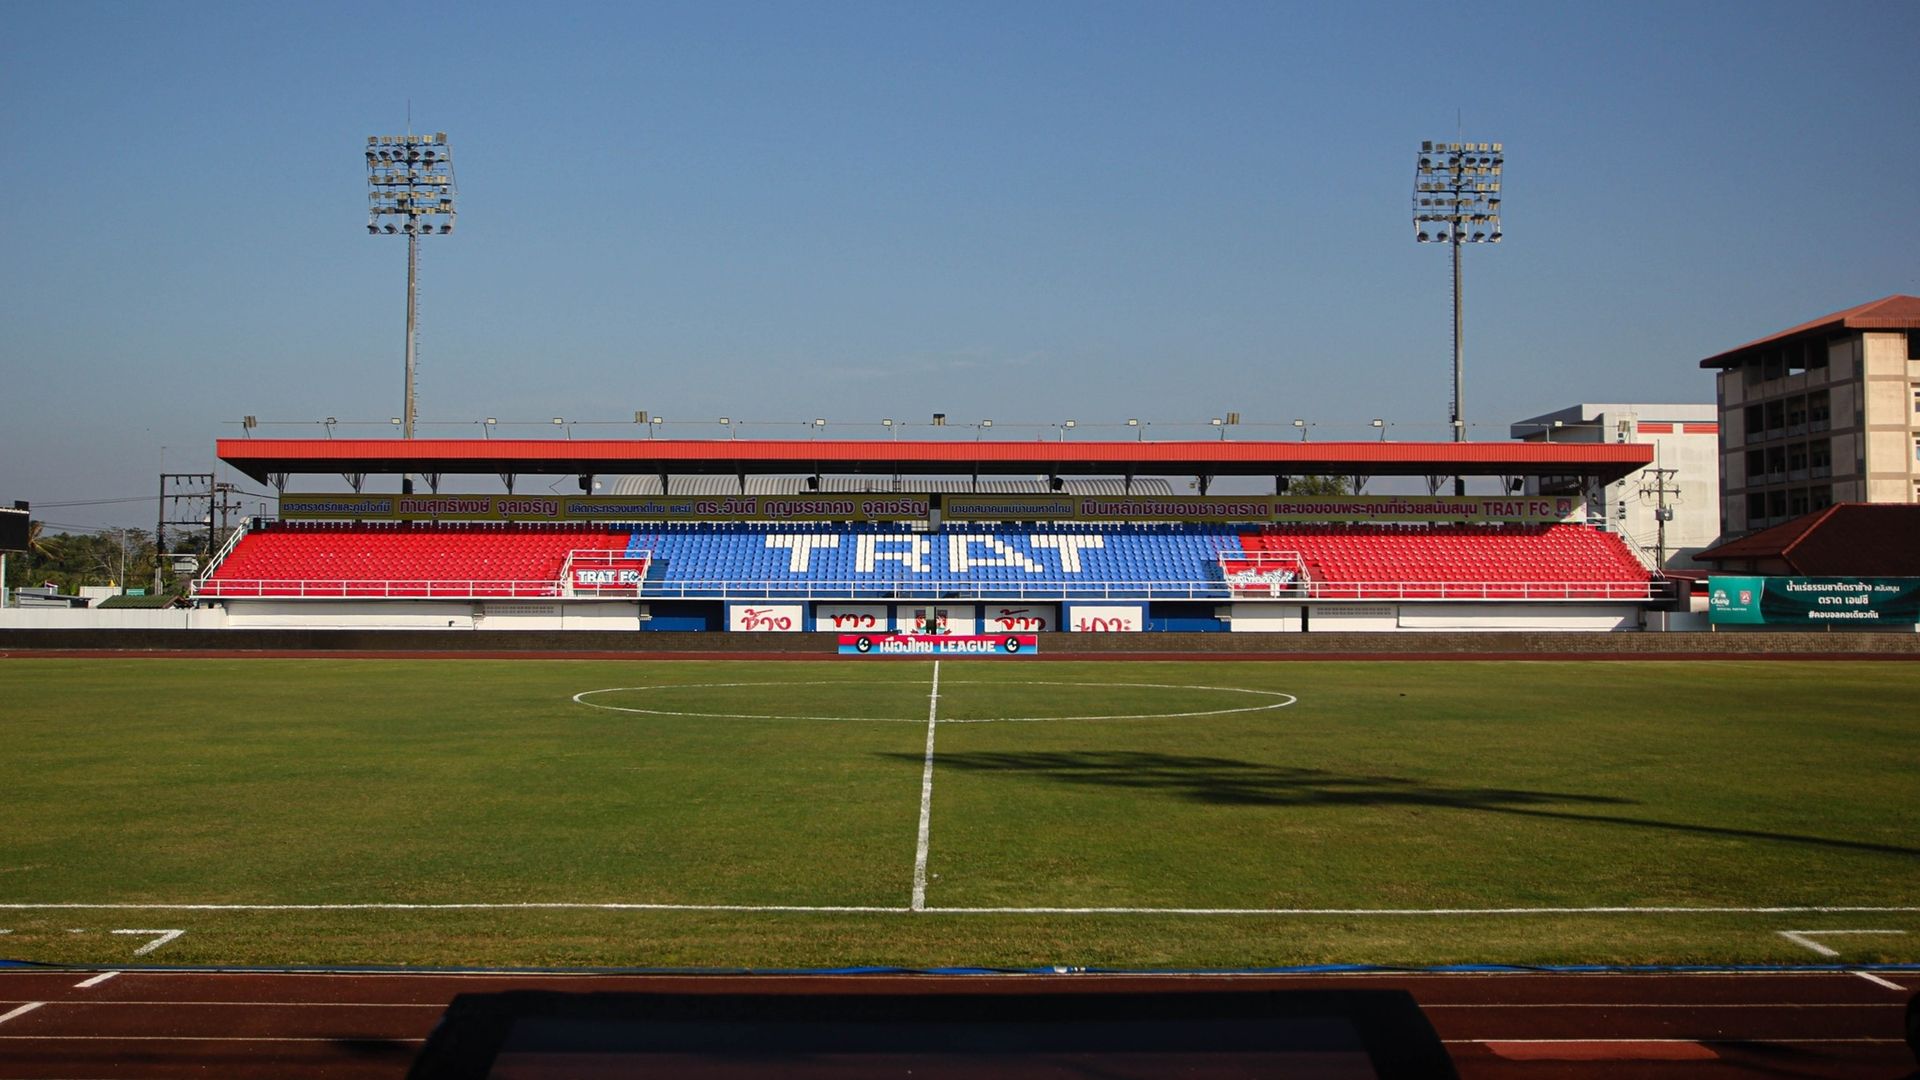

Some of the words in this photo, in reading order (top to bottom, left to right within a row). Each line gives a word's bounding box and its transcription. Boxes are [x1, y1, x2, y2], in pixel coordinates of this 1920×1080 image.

[400, 497, 491, 516] ท่านสุทธิพงษ์
[497, 498, 558, 517] จุลเจริญ
[695, 498, 756, 514] ดร.วันดี
[764, 501, 853, 517] กุญชรยาคง
[862, 498, 928, 517] จุลเจริญ
[1081, 499, 1268, 516] เป็นหลักชัยของชาวตราด
[1483, 502, 1524, 515] TRAT
[1530, 502, 1549, 515] FC
[765, 534, 1104, 573] TRAT
[576, 569, 616, 584] TRAT
[619, 569, 641, 584] FC
[1818, 596, 1842, 605] ตราด
[1845, 594, 1869, 605] เอฟซี
[741, 609, 792, 631] ช้าง
[940, 640, 996, 653] LEAGUE
